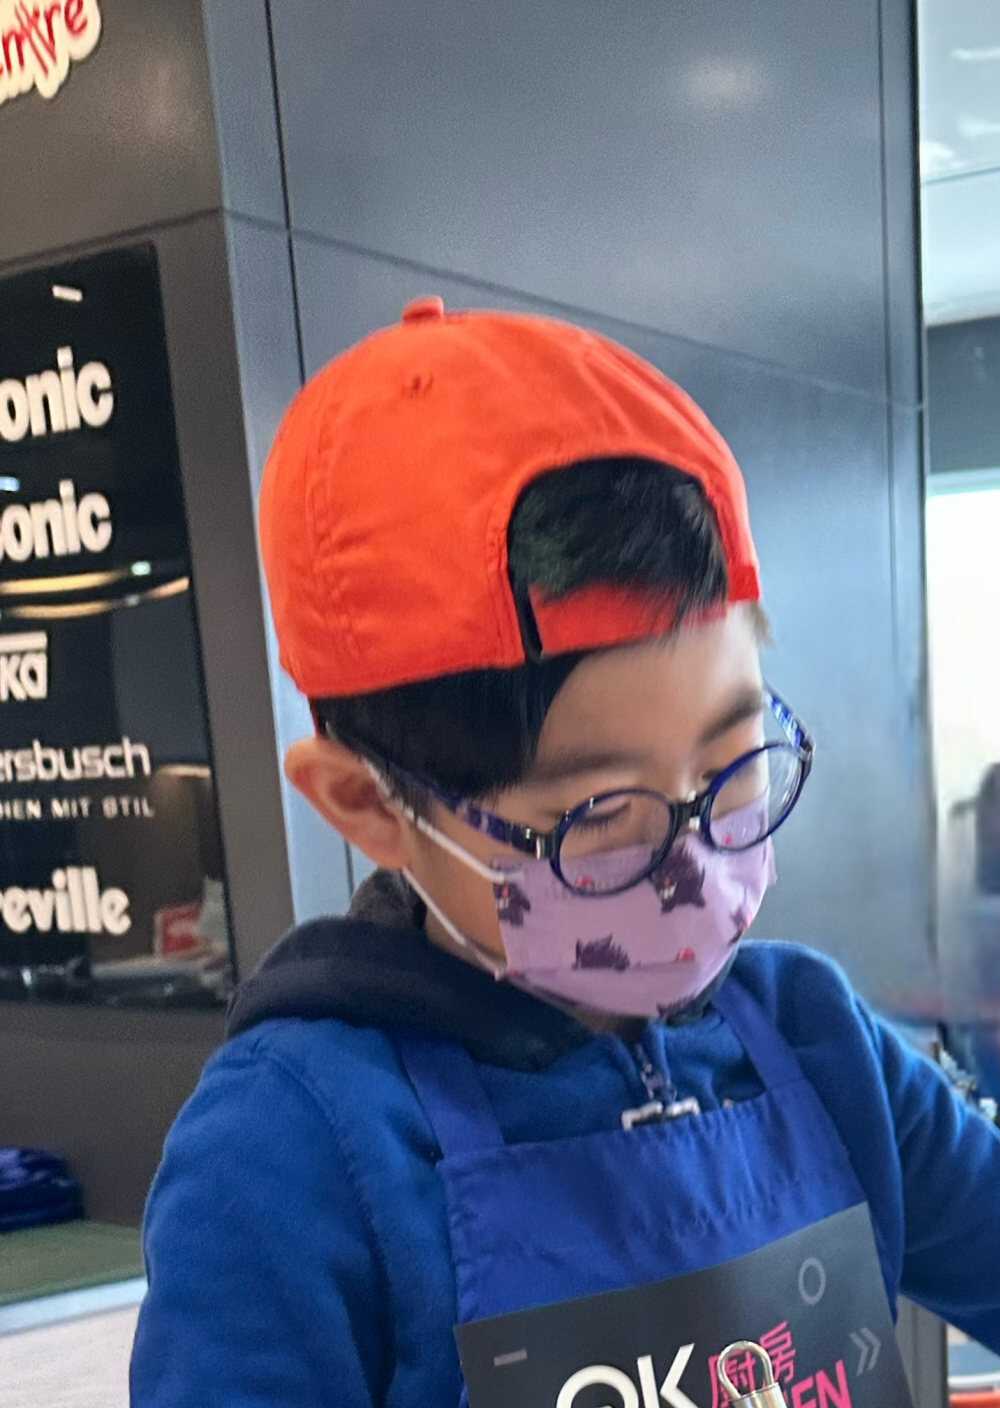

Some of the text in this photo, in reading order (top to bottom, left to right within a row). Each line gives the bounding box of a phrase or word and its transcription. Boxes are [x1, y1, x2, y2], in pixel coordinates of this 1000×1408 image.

[0, 0, 88, 79] ntre
[0, 479, 112, 562] onic
[0, 736, 150, 783] rsbusch
[0, 866, 131, 936] eville
